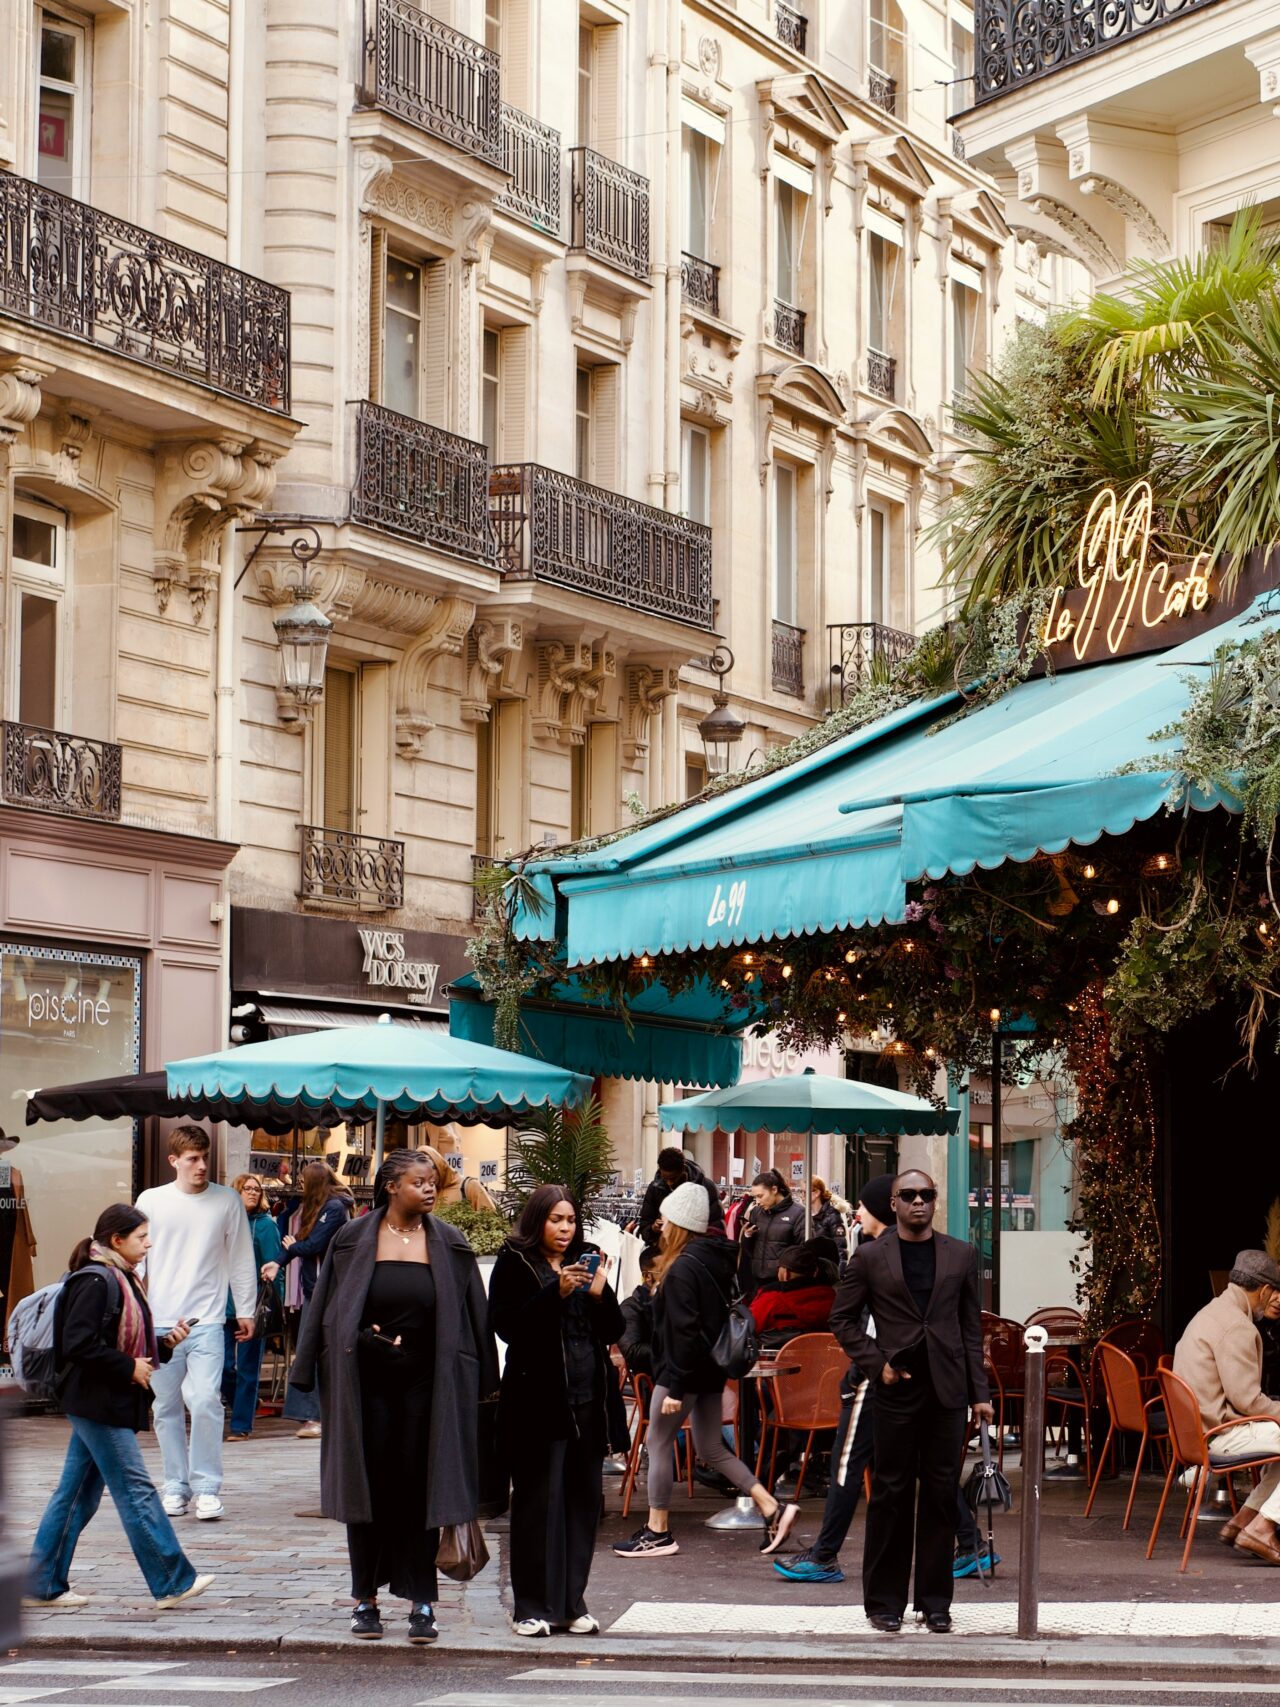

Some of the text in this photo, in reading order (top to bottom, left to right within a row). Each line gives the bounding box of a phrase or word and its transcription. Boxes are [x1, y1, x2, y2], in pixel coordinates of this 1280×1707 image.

[1043, 585, 1076, 648] Le
[1073, 480, 1153, 661] 99
[706, 880, 747, 928] Le 99
[28, 988, 111, 1028] piscine
[63, 1029, 76, 1039] PARIS
[346, 1157, 369, 1175] 10€
[447, 1157, 462, 1169] 10€
[480, 1164, 497, 1177] 20€
